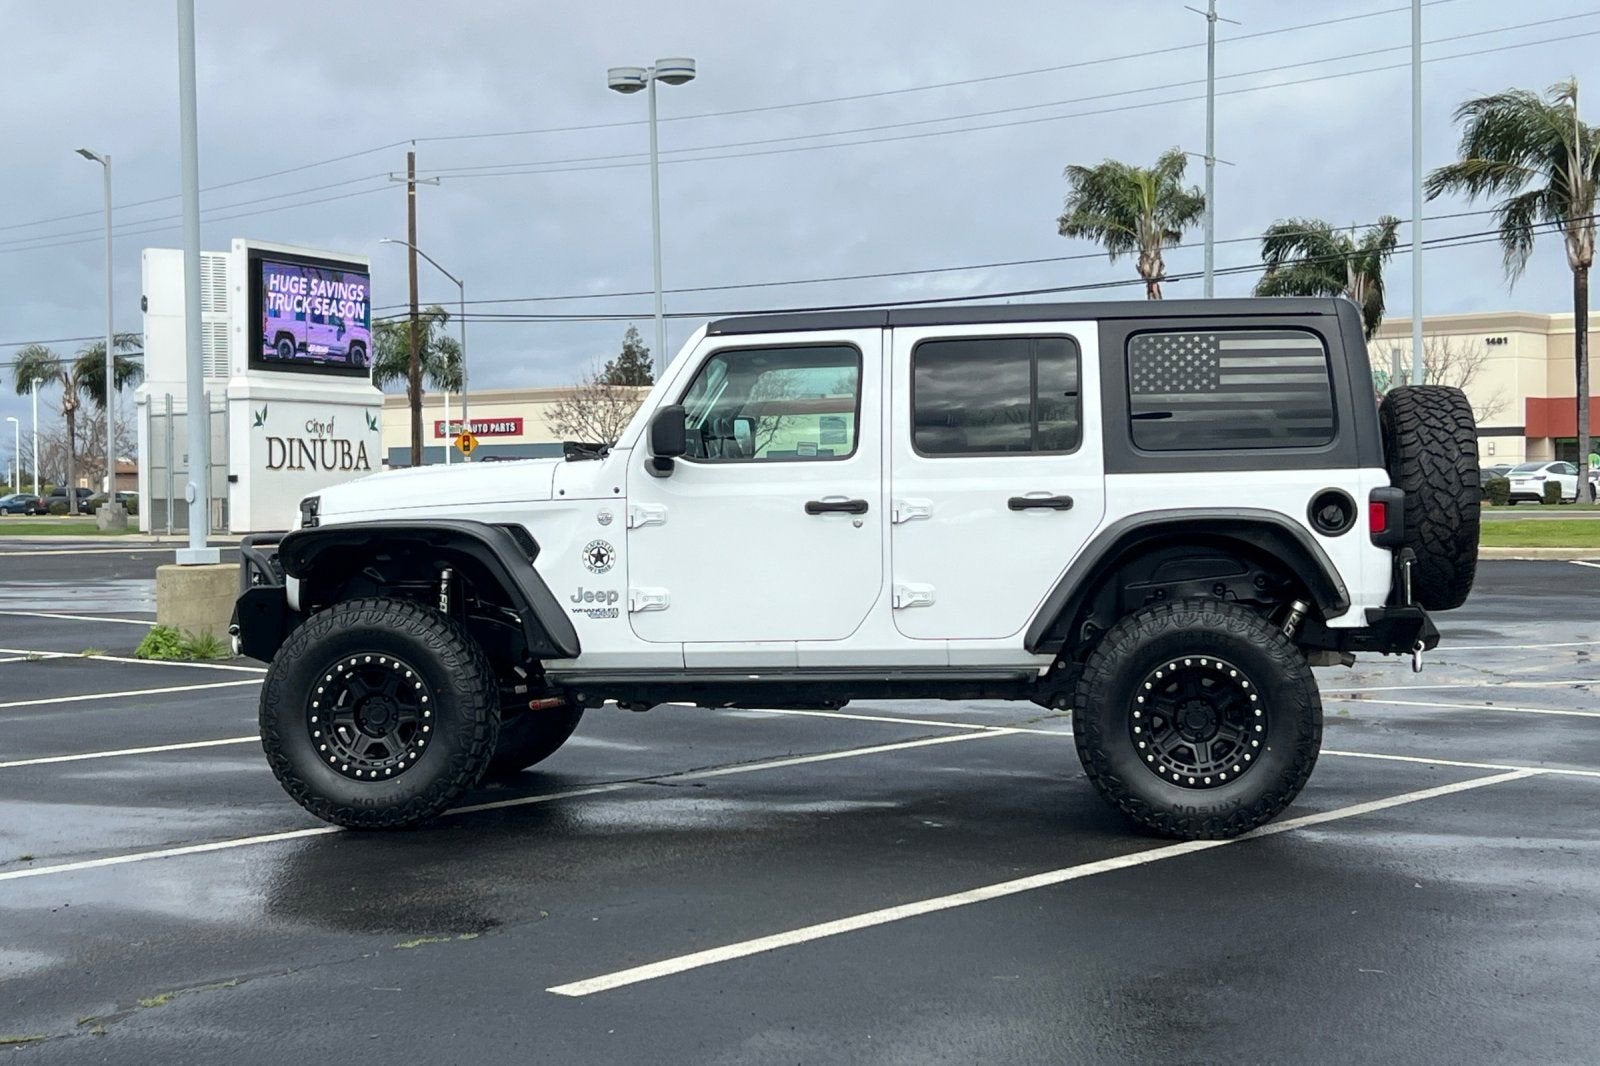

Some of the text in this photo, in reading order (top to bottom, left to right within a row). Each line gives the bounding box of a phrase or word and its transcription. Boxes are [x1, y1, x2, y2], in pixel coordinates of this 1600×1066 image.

[269, 273, 364, 301] HUGE SAVINGS
[268, 292, 365, 319] TRUCK SEASON
[305, 415, 335, 438] City of
[490, 422, 516, 432] PARTS
[265, 436, 371, 471] DINUBA
[570, 586, 619, 606] Jeep
